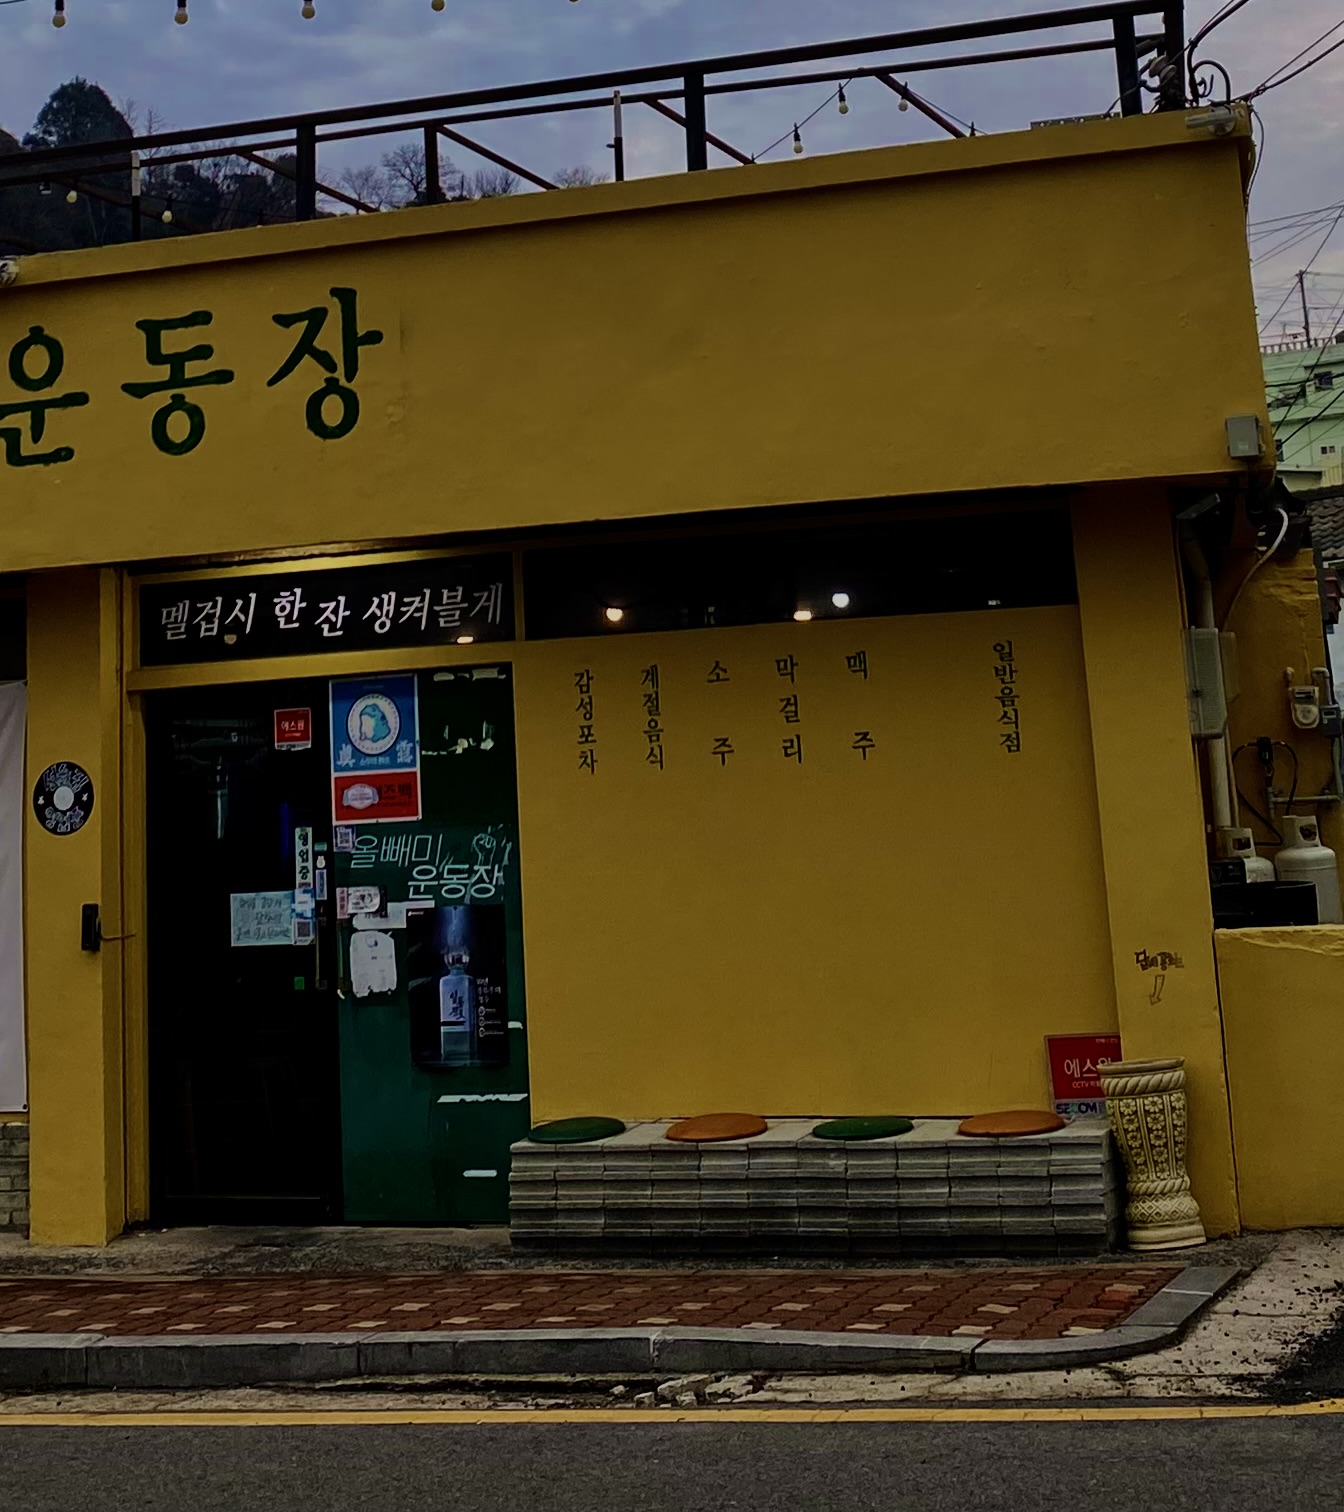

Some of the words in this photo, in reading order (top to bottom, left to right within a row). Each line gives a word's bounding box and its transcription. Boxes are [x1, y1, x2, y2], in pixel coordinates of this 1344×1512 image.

[160, 591, 256, 641] 멜겁시
[272, 587, 308, 630] 한
[314, 594, 351, 638] 잔
[573, 668, 599, 775] 감성포차
[640, 663, 665, 771] 계절음식
[706, 660, 735, 766] 소주
[775, 653, 804, 765] 막걸리
[845, 650, 876, 761] 맥주
[992, 639, 1023, 754] 일반음식점
[350, 833, 443, 869] 올빼미
[407, 862, 505, 900] 운동장
